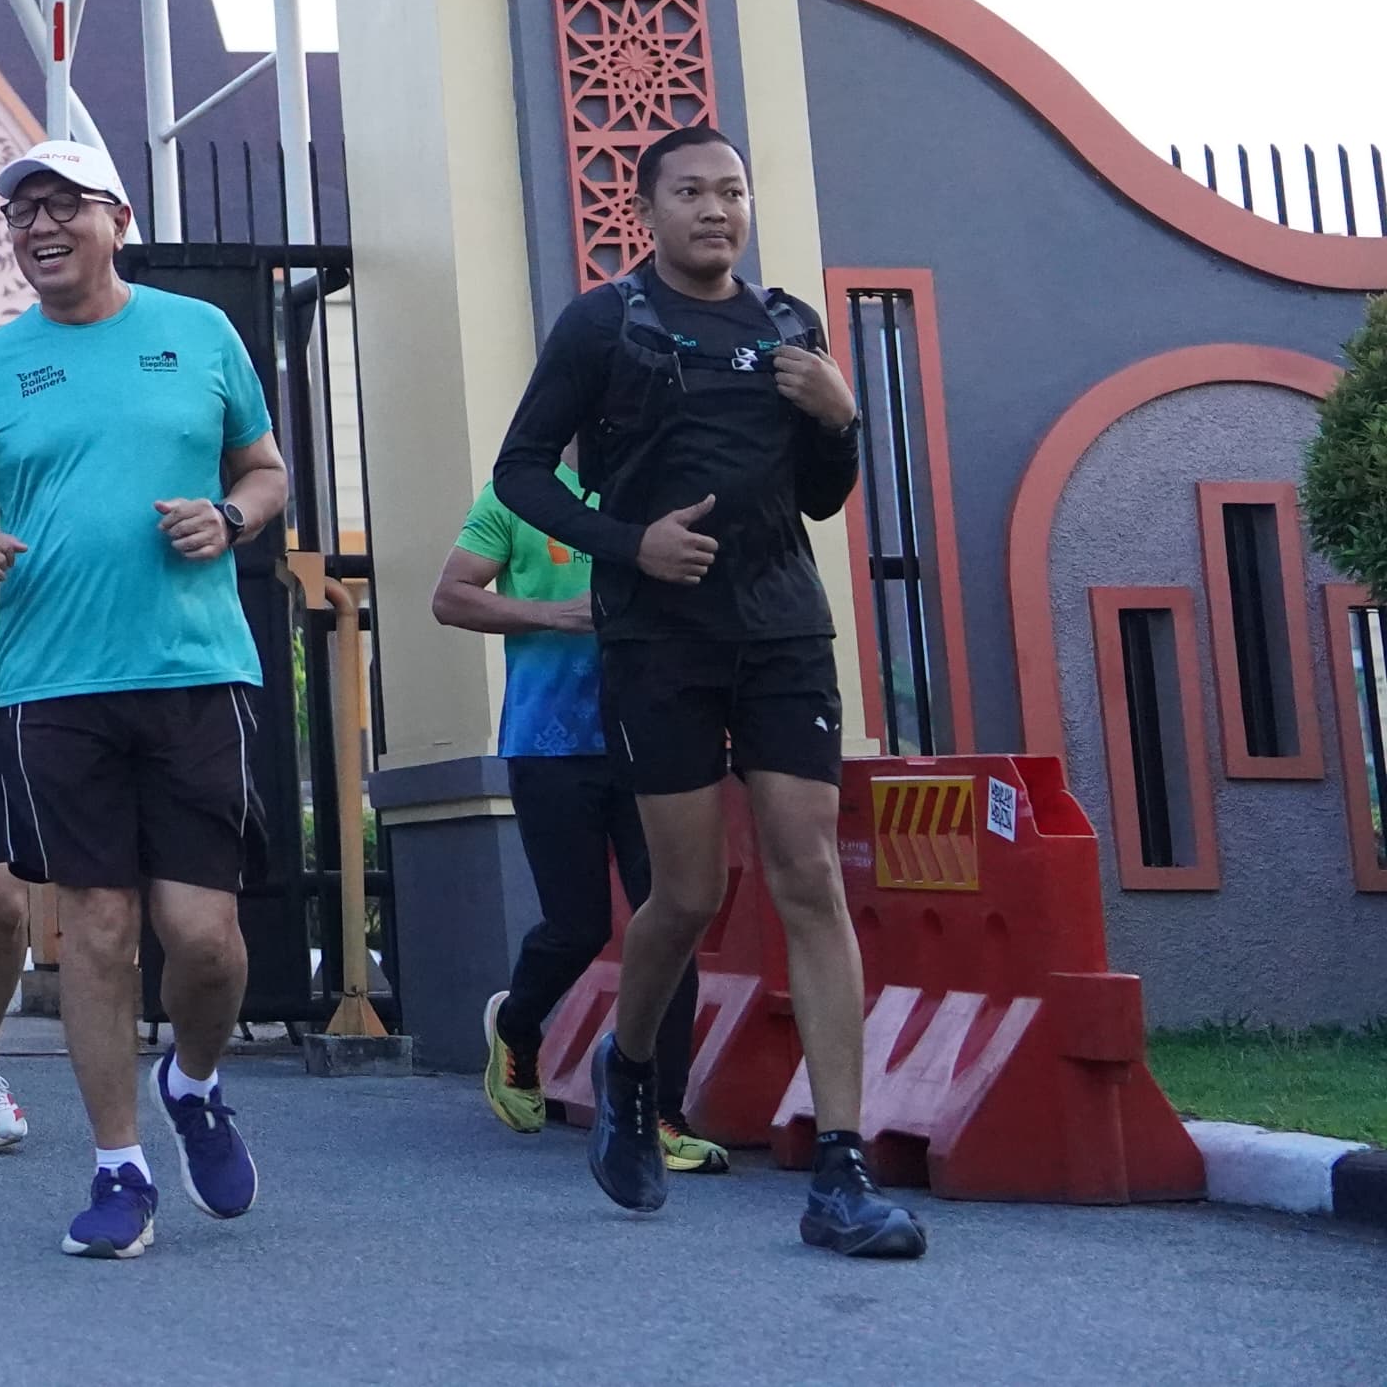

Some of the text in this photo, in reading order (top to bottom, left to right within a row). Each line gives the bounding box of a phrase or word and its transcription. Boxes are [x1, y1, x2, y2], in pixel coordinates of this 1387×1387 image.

[17, 365, 53, 382] Green
[139, 360, 178, 369] Elephant
[20, 369, 65, 390] Policing
[22, 376, 67, 398] Runners
